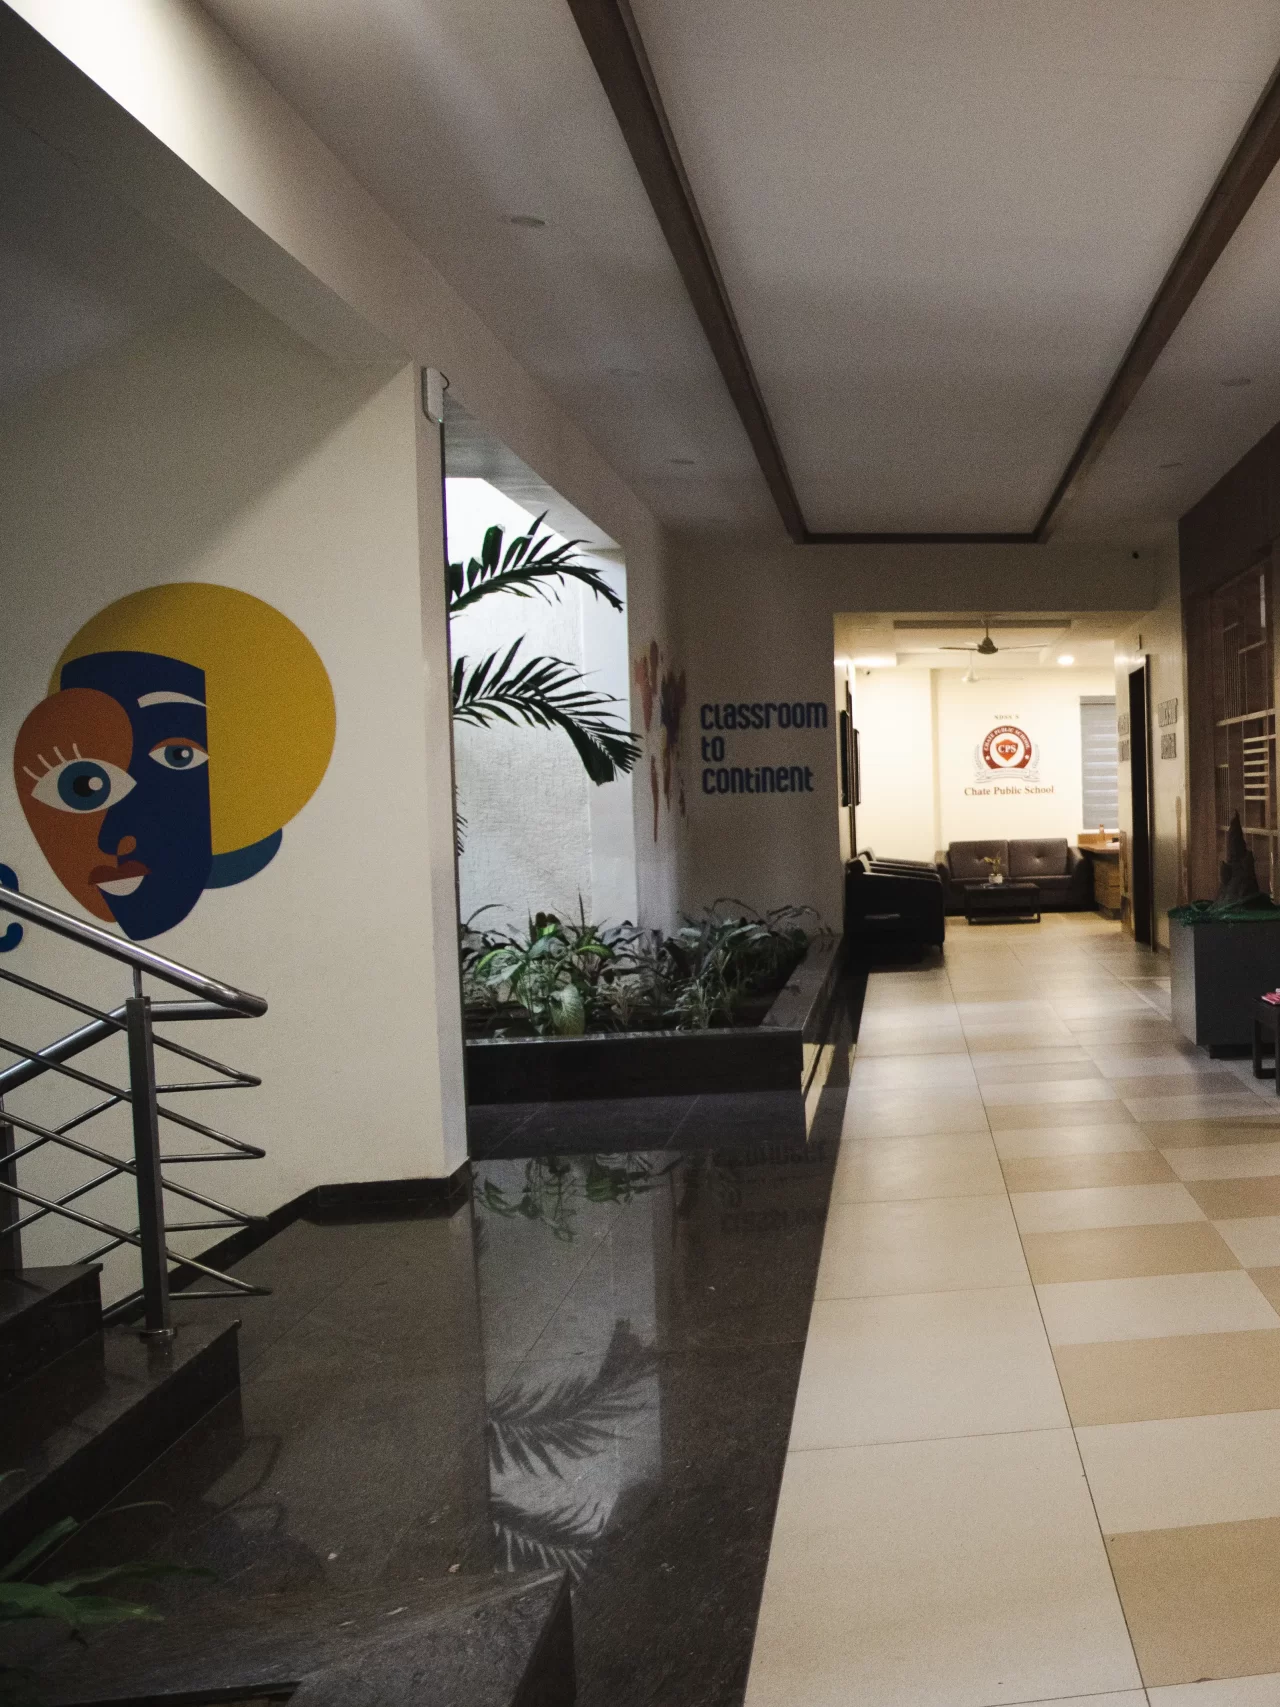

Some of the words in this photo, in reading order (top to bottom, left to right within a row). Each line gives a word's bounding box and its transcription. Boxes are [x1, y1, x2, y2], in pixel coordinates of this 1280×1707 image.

[701, 736, 725, 762] to
[998, 744, 1017, 753] CPS
[964, 787, 991, 796] Chate
[993, 786, 1022, 795] Public
[1024, 785, 1054, 794] School
